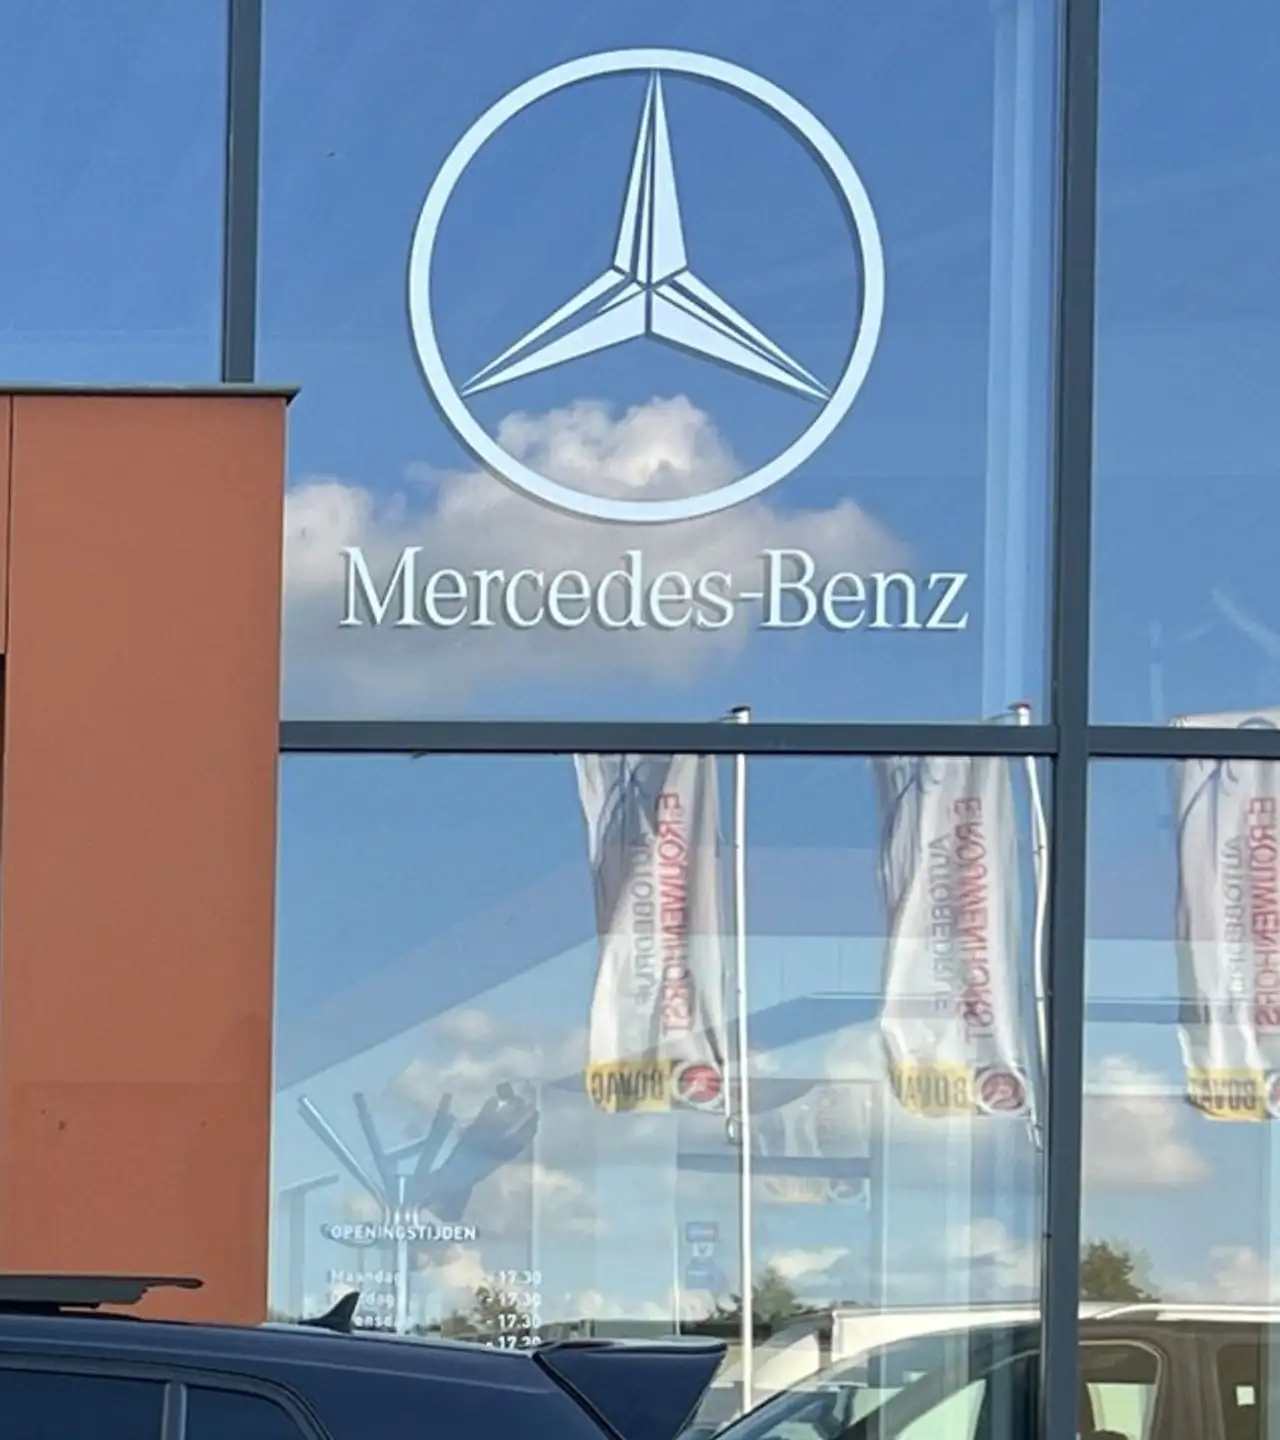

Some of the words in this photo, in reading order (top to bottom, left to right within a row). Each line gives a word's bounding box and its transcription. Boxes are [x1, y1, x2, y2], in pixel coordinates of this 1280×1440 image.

[339, 546, 970, 631] Mercedes-Benz
[329, 1223, 477, 1242] OPENINGSTIJDEN
[497, 1313, 542, 1329] 17.30
